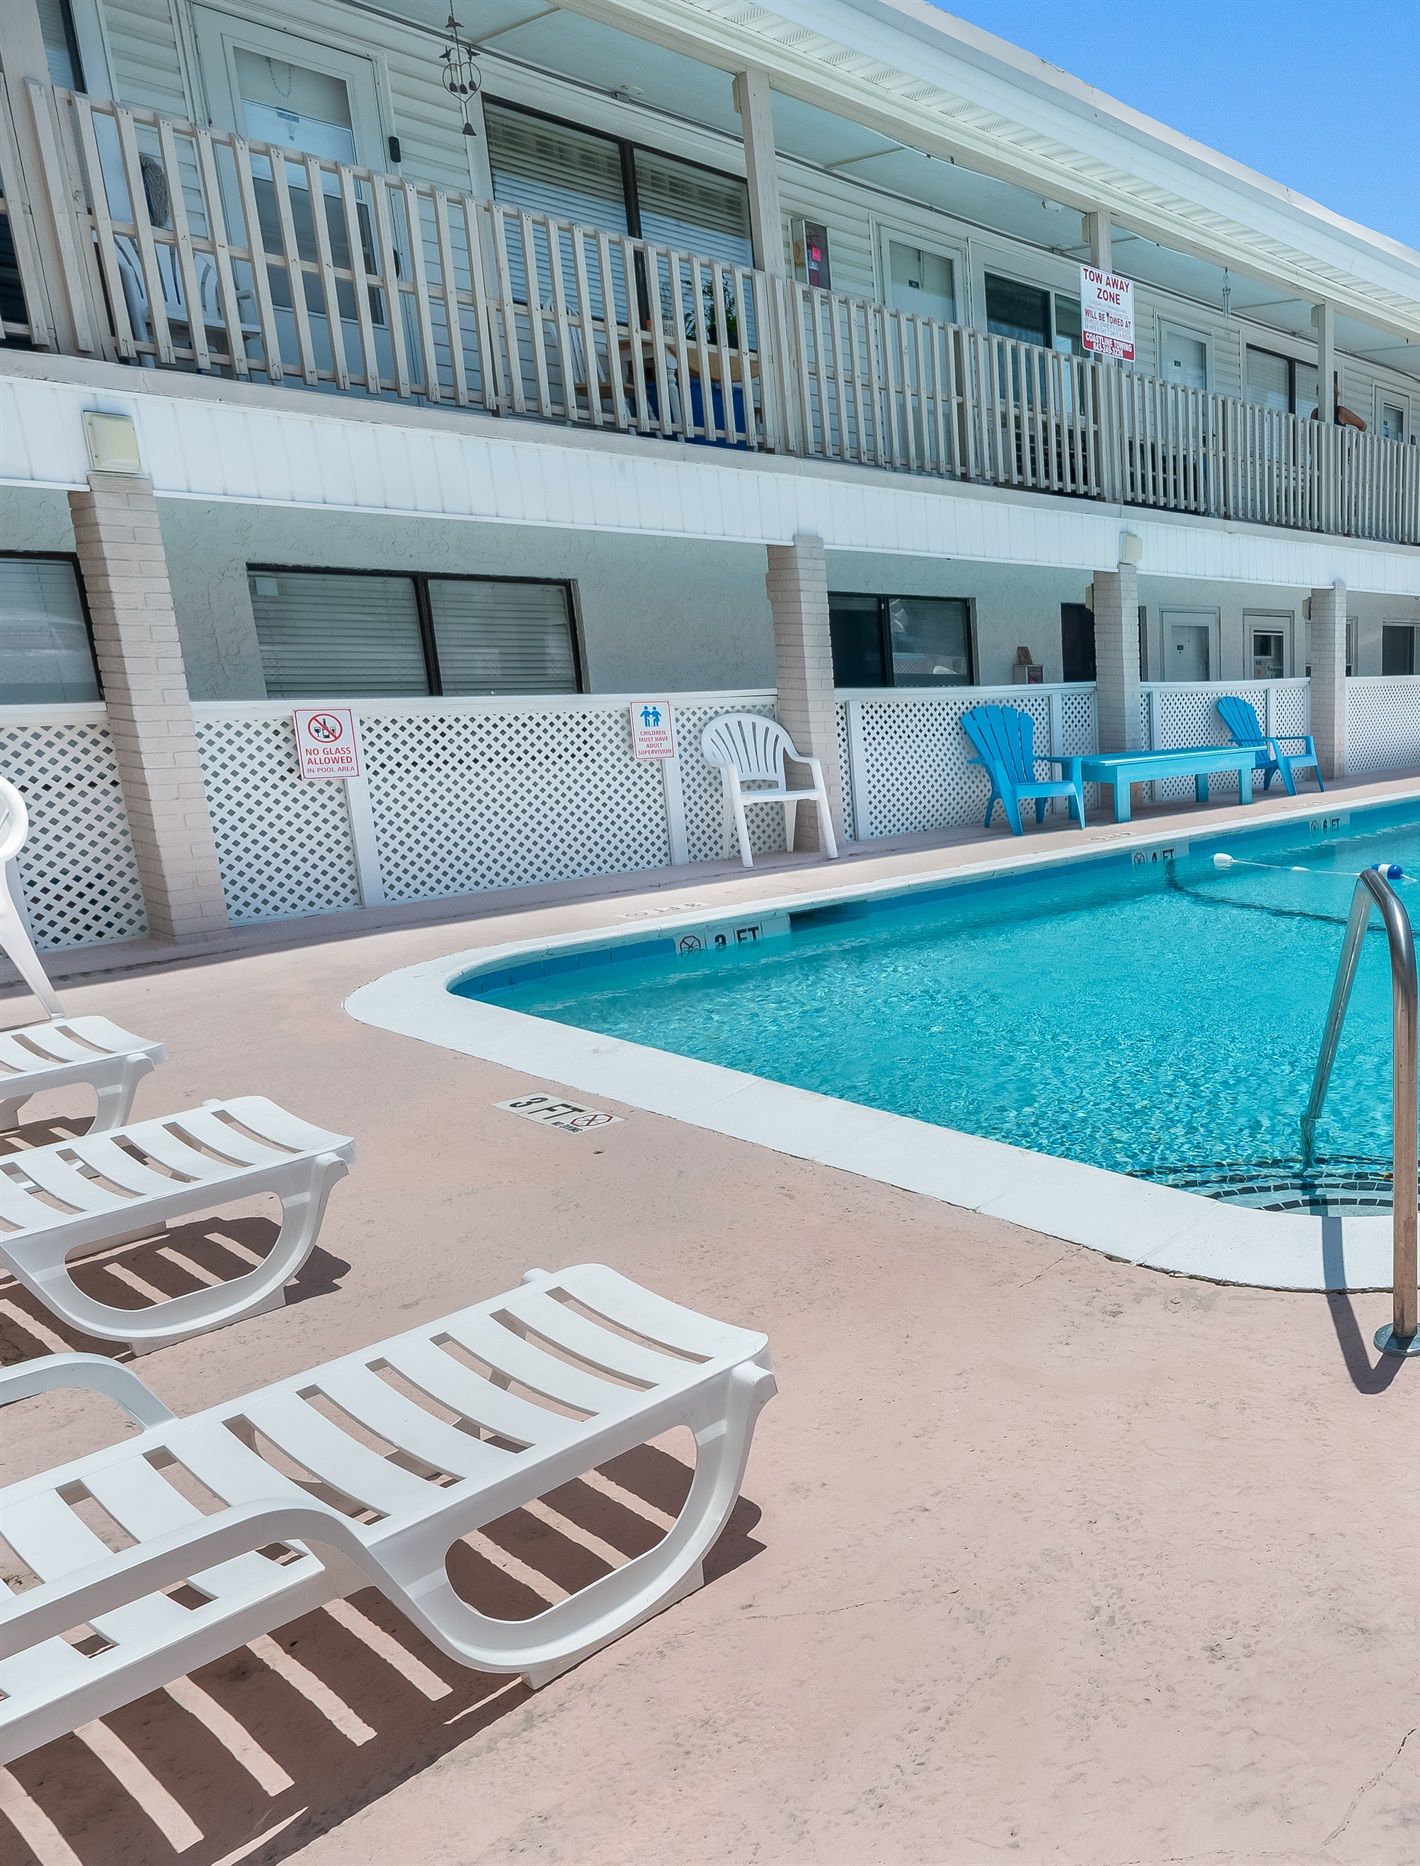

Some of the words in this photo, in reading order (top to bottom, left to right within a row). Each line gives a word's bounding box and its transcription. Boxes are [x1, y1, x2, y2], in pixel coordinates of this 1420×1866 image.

[1083, 268, 1102, 284] TOW
[1106, 276, 1130, 293] AWAY
[1097, 287, 1121, 305] ZONE
[1085, 308, 1097, 319] WILL
[1099, 312, 1105, 322] BE
[1106, 314, 1124, 327] TOWED
[1125, 320, 1131, 329] AT
[305, 748, 320, 756] NO
[322, 747, 351, 756] GLASS
[307, 756, 353, 765] ALLOWED
[1162, 848, 1174, 860] FT
[736, 926, 759, 943] FT
[509, 1097, 549, 1108] 3
[527, 1103, 587, 1120] FT
